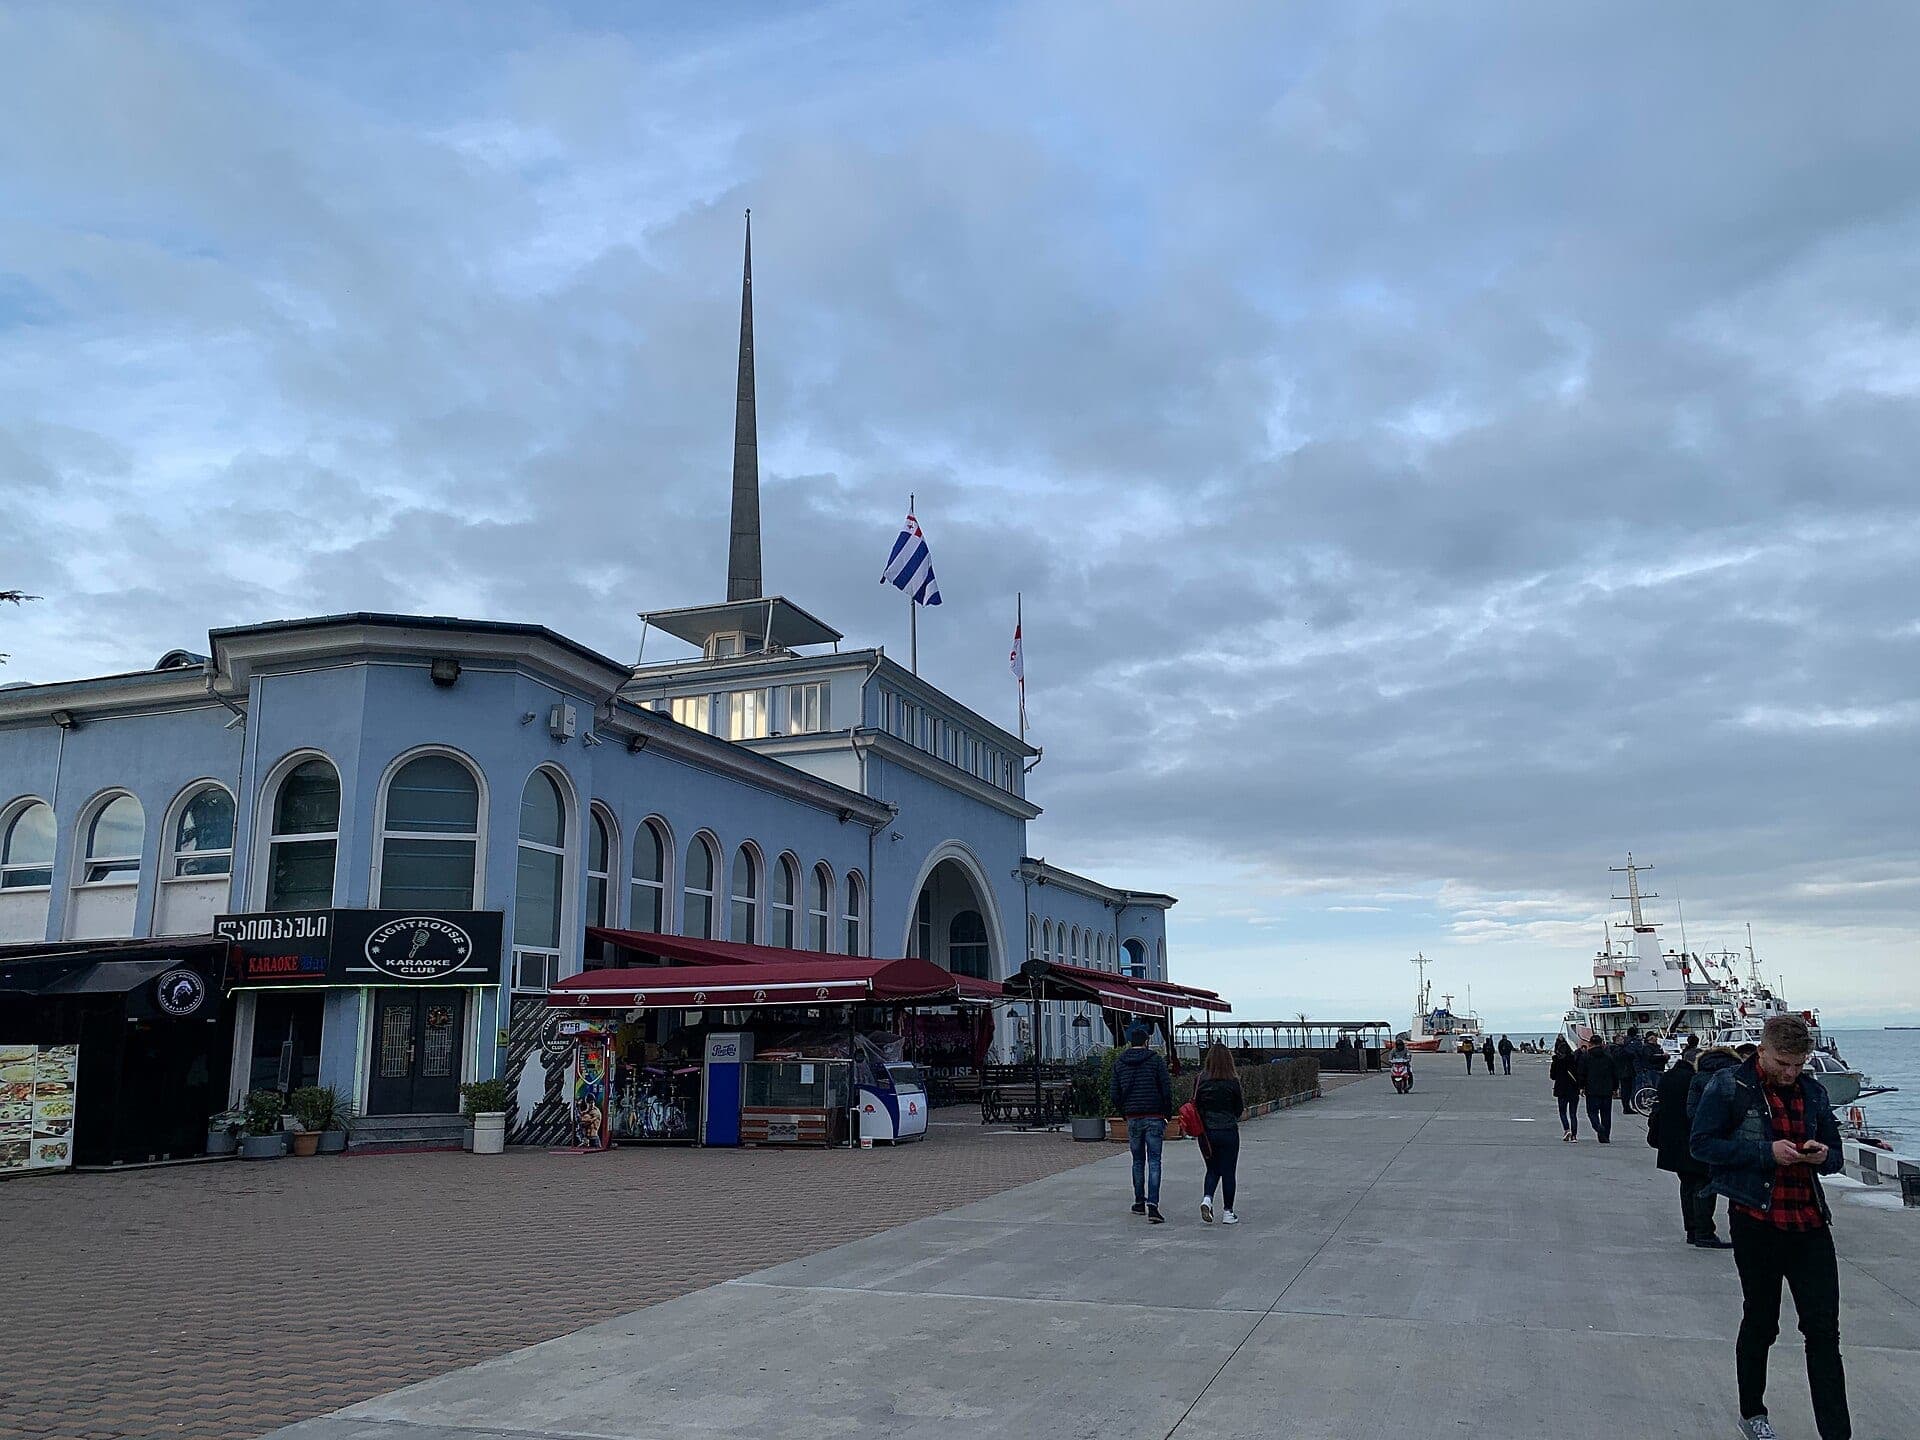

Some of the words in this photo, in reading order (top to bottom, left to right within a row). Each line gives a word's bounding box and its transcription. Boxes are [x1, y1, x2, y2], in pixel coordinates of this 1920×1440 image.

[217, 916, 328, 941] ლაითჰაუსი
[374, 920, 465, 944] LIGHTHOUSE
[248, 955, 300, 973] KARAOKE
[385, 959, 451, 967] KARAOKE
